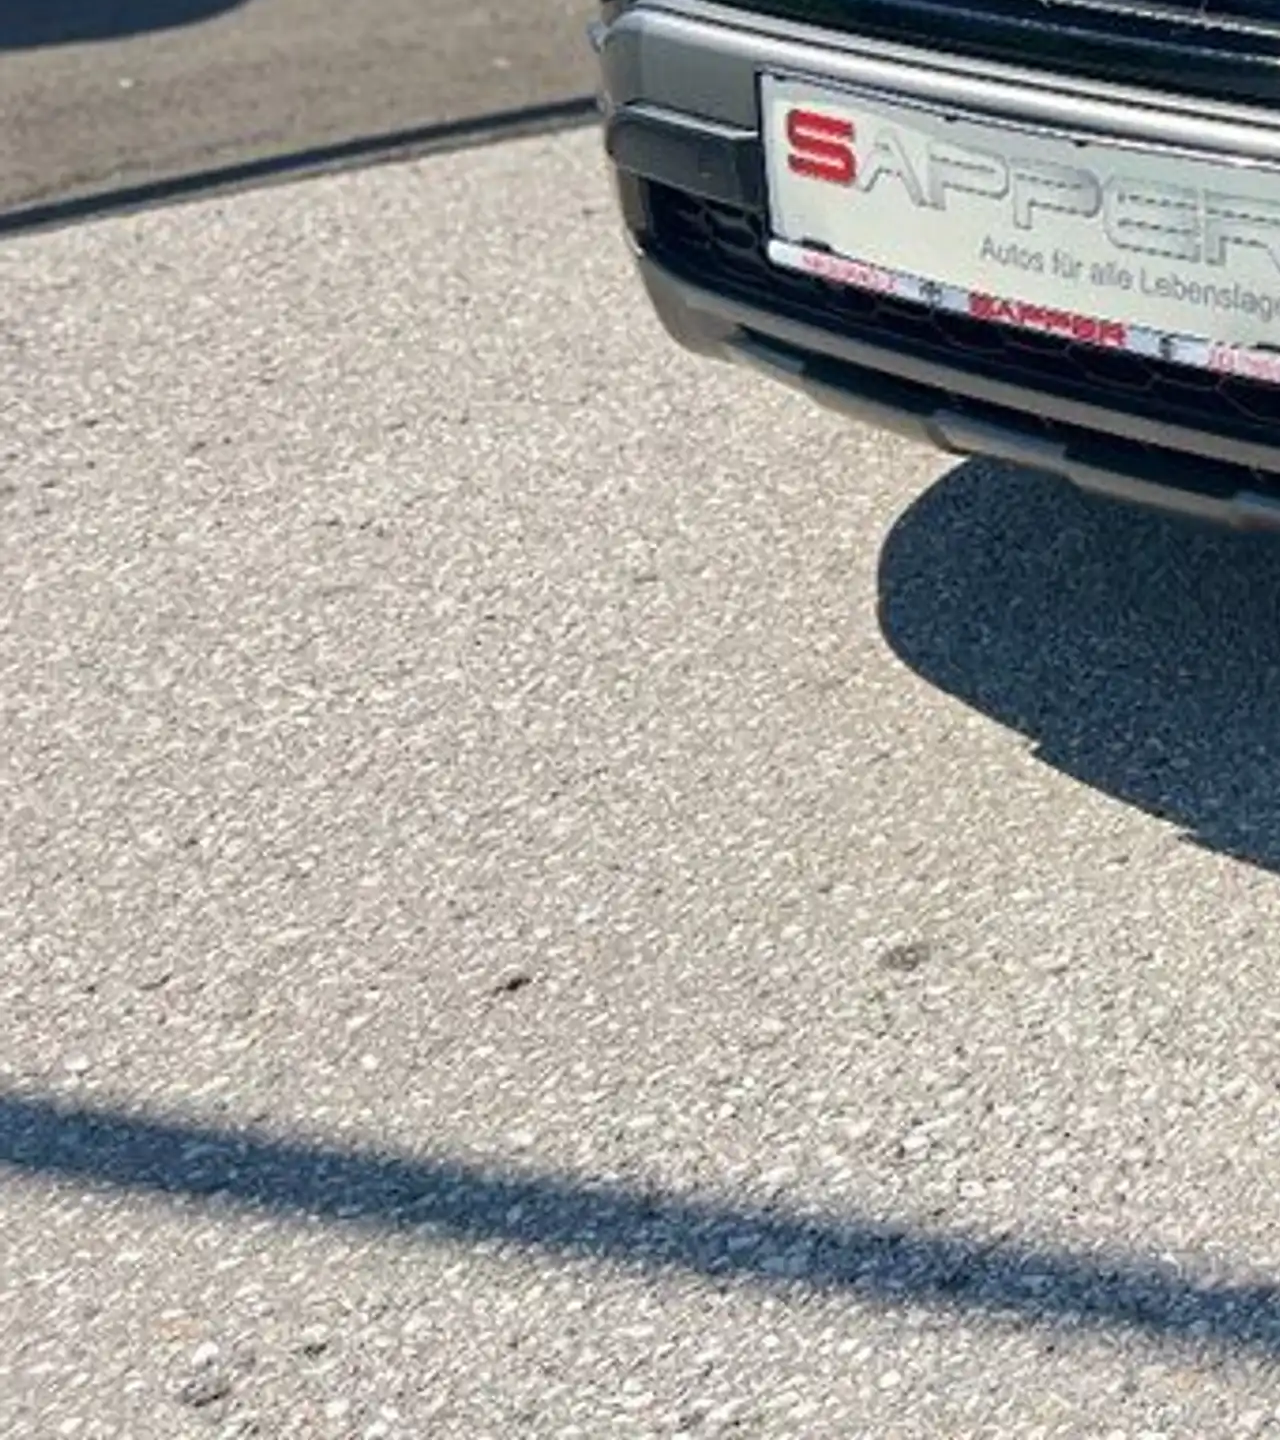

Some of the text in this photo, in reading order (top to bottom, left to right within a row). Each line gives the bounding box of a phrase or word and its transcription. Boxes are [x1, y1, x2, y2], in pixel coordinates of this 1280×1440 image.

[980, 233, 1044, 273] Autos
[1052, 247, 1083, 280] für
[1091, 258, 1133, 292] alle
